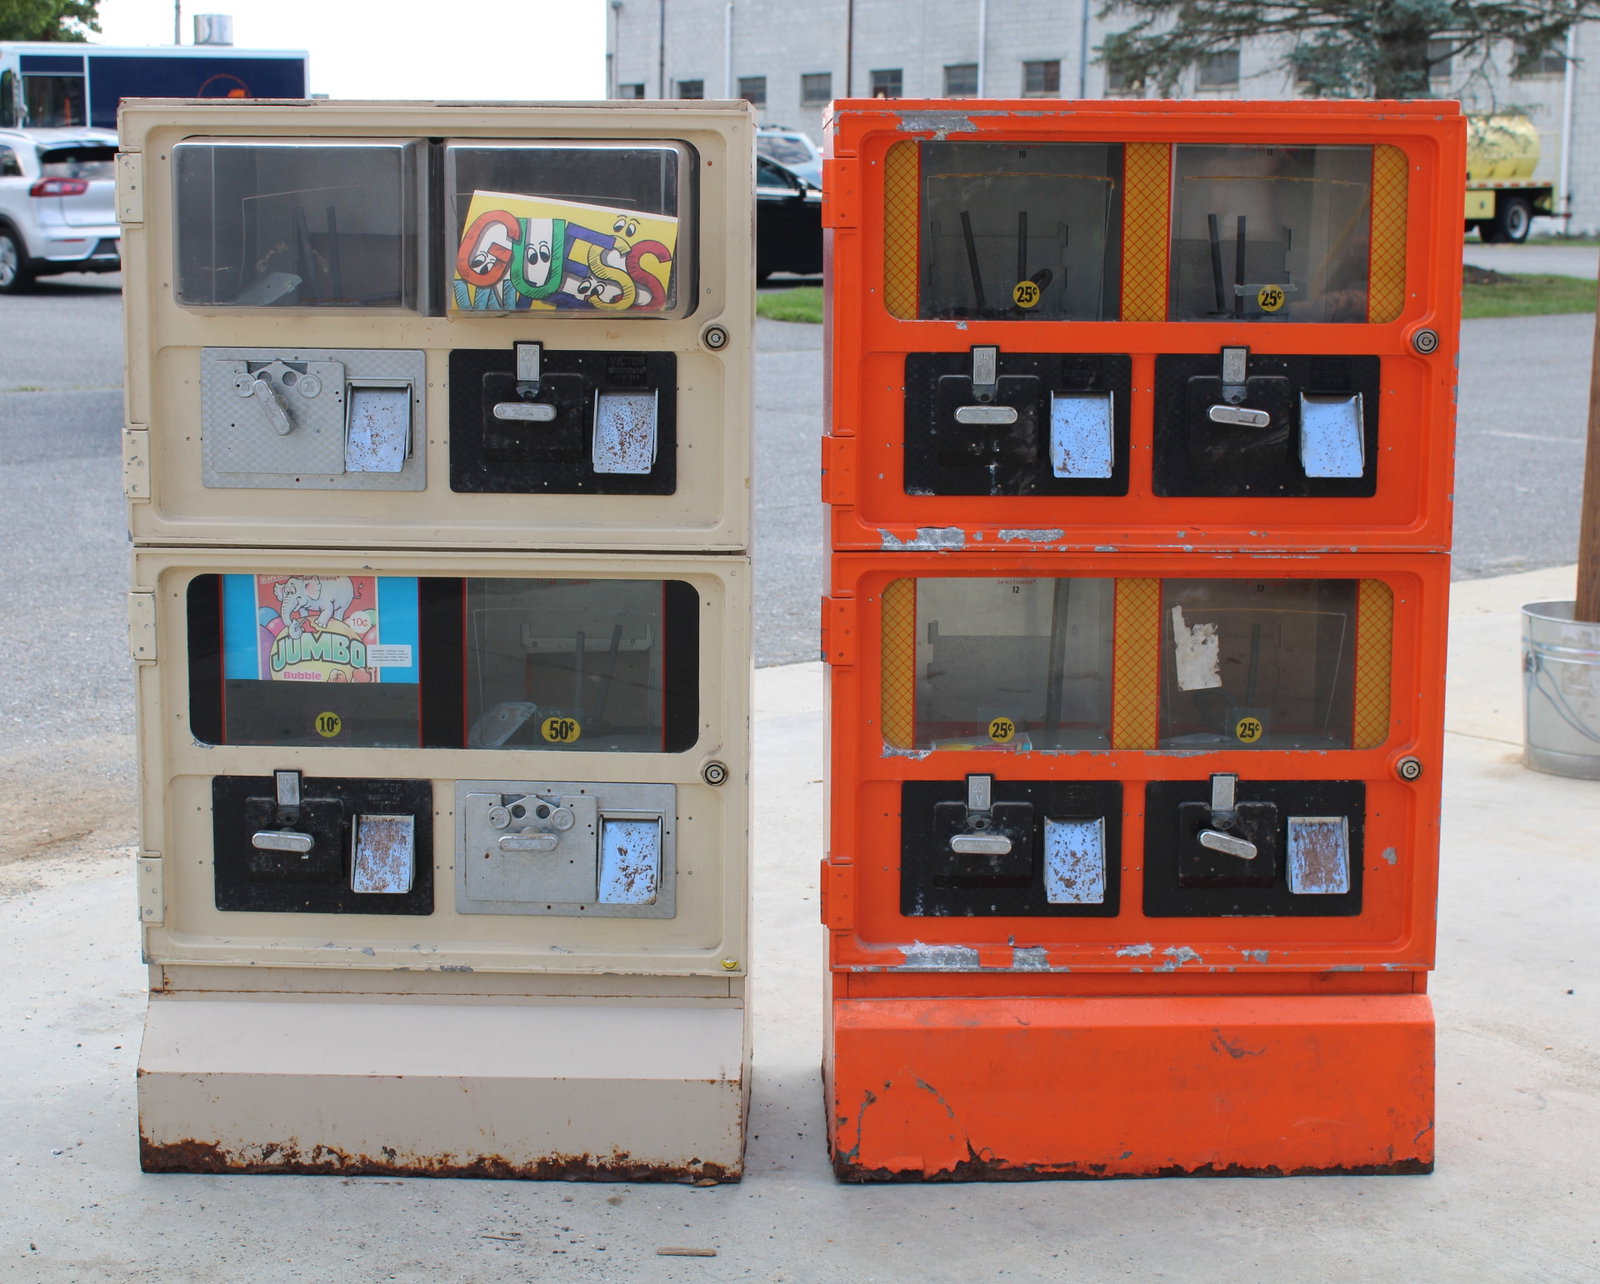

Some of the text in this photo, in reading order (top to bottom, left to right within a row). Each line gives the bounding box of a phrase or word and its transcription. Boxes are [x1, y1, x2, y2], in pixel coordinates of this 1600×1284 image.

[456, 210, 673, 311] GUESS
[1016, 286, 1038, 303] 25¢
[1261, 290, 1283, 307] 25¢
[271, 631, 367, 672] JUMBO
[283, 671, 322, 681] Bubble
[319, 716, 339, 733] 10¢
[549, 719, 575, 740] 50¢
[992, 722, 1013, 739] 25¢
[1239, 722, 1260, 739] 25¢
